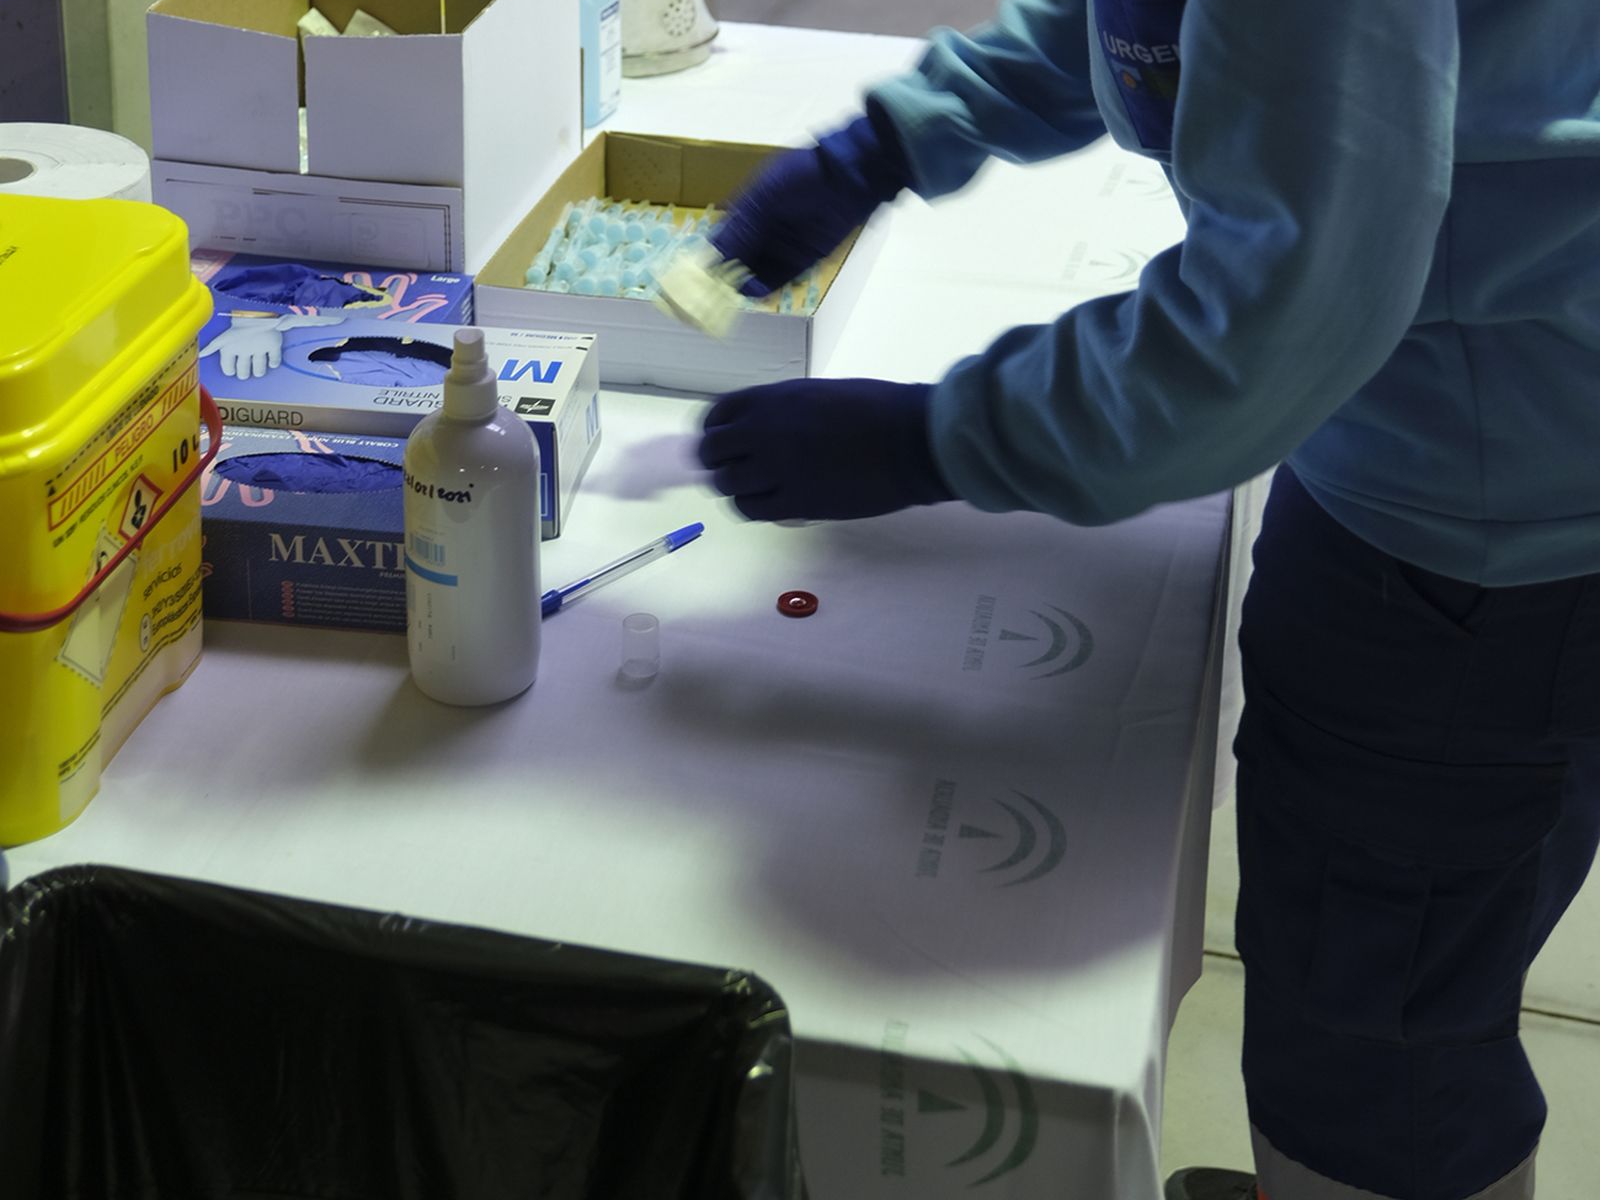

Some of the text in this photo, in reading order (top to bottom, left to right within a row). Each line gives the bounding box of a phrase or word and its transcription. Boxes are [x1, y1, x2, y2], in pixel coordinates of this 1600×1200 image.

[430, 275, 461, 284] Large
[497, 358, 563, 384] M
[378, 388, 440, 399] NITRILE
[113, 414, 154, 462] PELIGRO
[172, 438, 188, 473] 10
